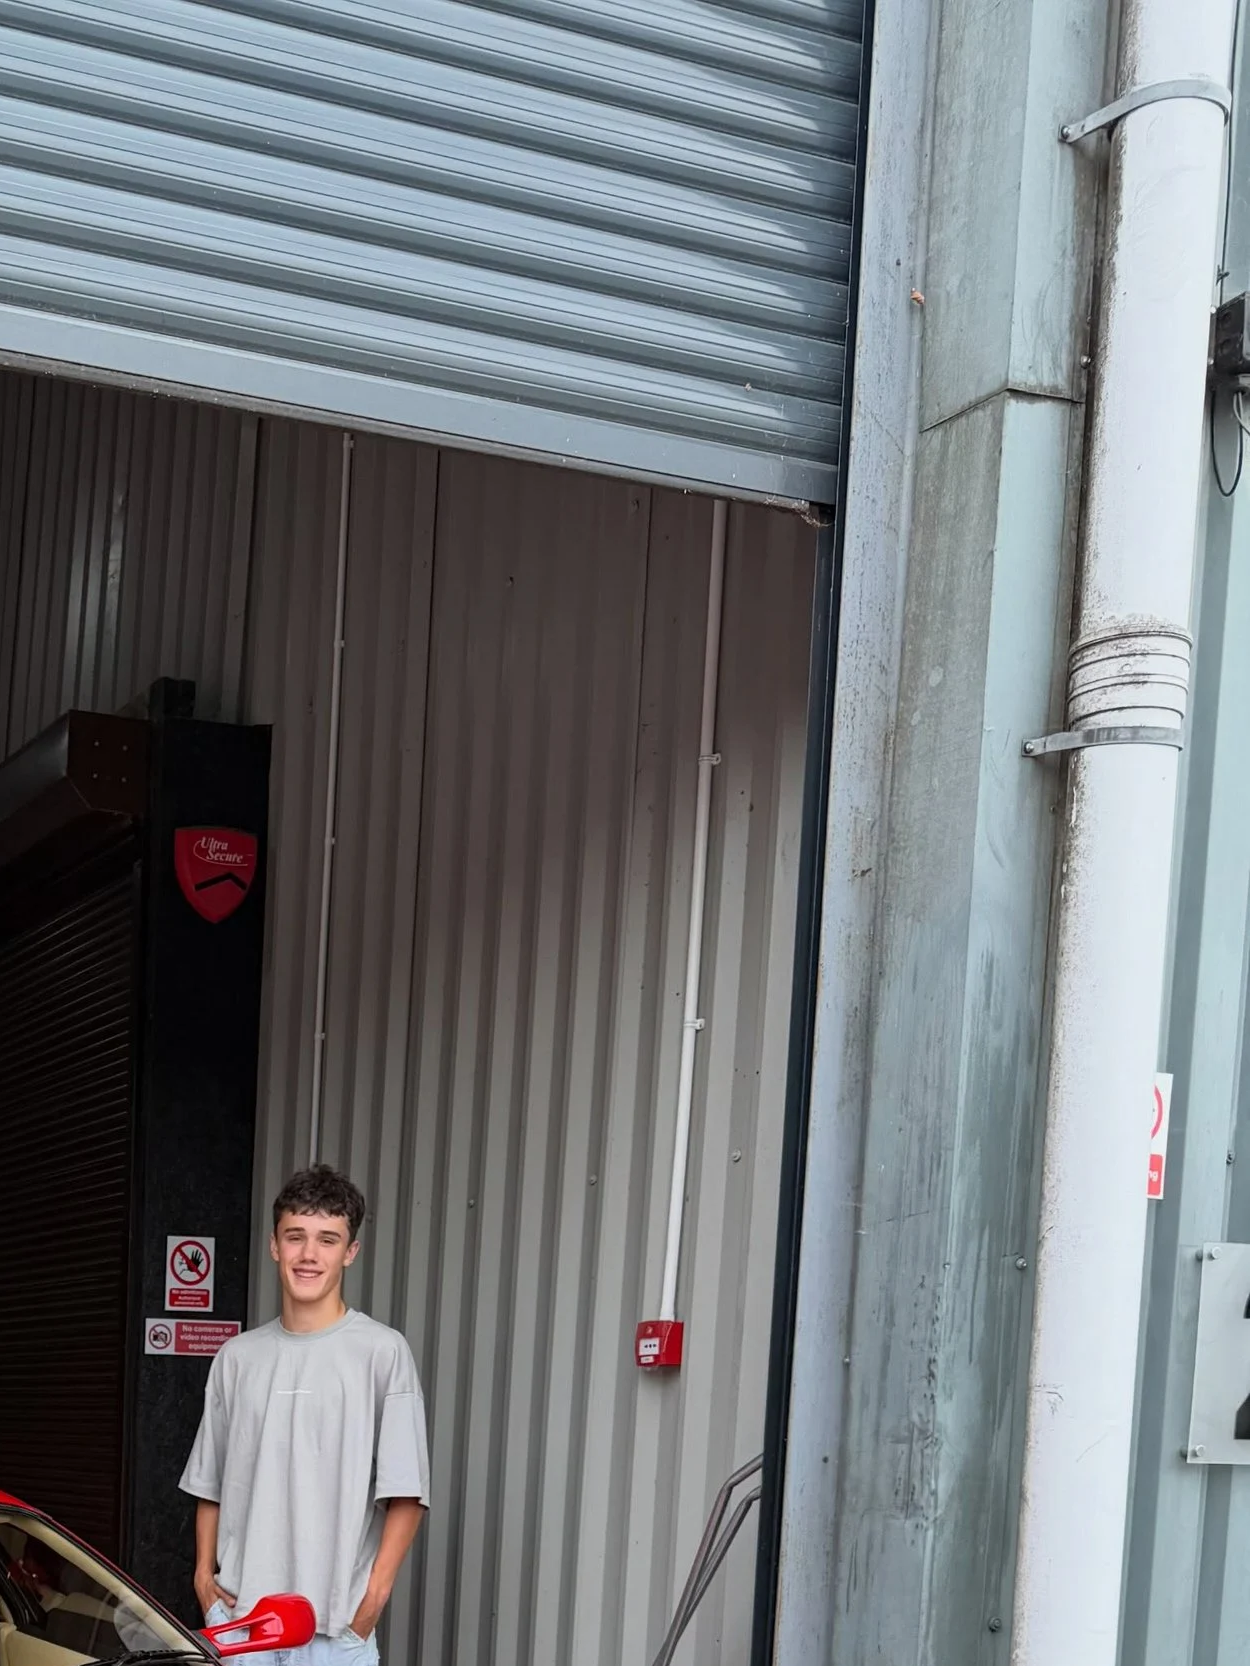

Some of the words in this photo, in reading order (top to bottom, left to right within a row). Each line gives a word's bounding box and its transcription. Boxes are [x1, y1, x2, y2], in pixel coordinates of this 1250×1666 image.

[201, 836, 228, 852] Ultra
[206, 849, 243, 863] Secure
[182, 1324, 192, 1333] No
[180, 1333, 199, 1341] video
